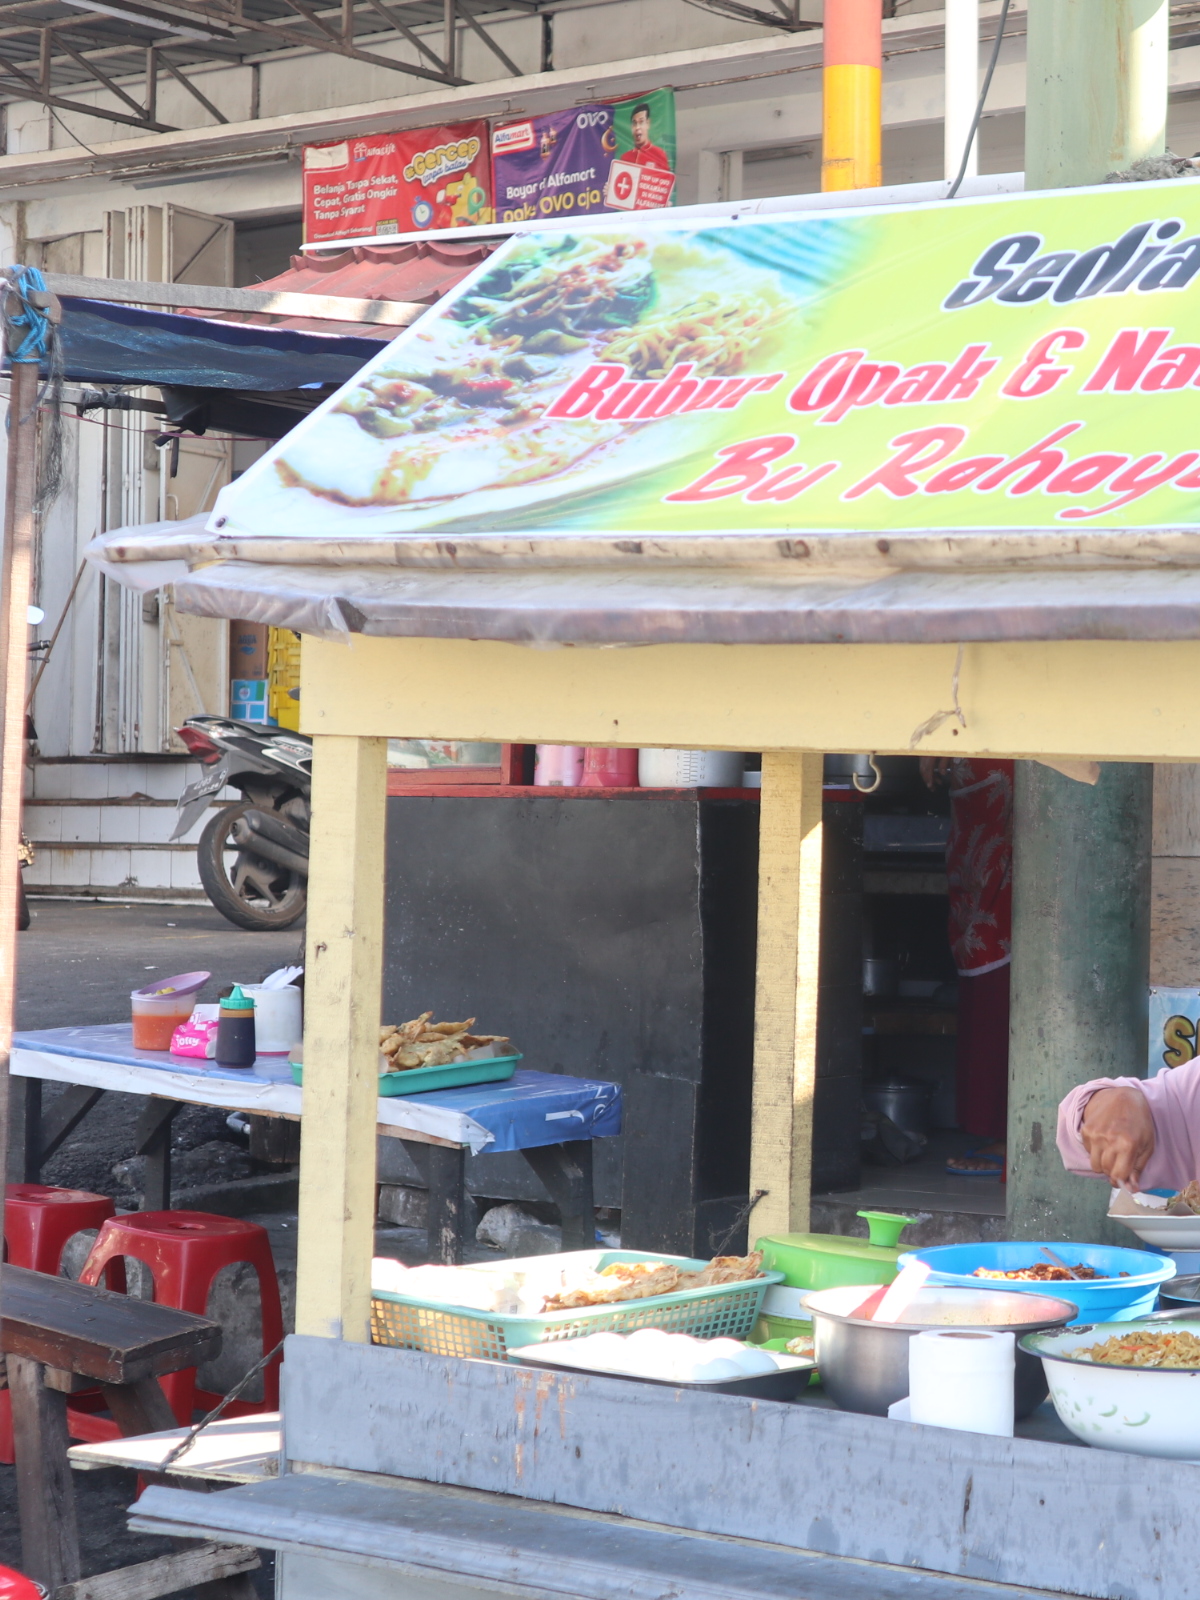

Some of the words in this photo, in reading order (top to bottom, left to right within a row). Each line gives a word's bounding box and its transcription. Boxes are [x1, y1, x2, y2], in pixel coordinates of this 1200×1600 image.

[495, 128, 529, 142] Alfamart
[405, 139, 478, 179] #Gercep
[313, 182, 345, 195] Belanja
[370, 174, 398, 185] Sekat,
[506, 183, 537, 199] Bayar
[313, 197, 341, 208] Cepat,
[367, 186, 398, 200] Ongkir
[540, 192, 575, 214] OVO
[313, 210, 339, 220] Tanpa
[340, 204, 365, 217] Syarat
[544, 362, 784, 421] Bubur
[788, 344, 998, 424] Opak
[1002, 329, 1086, 398] &
[665, 435, 839, 502] Bu
